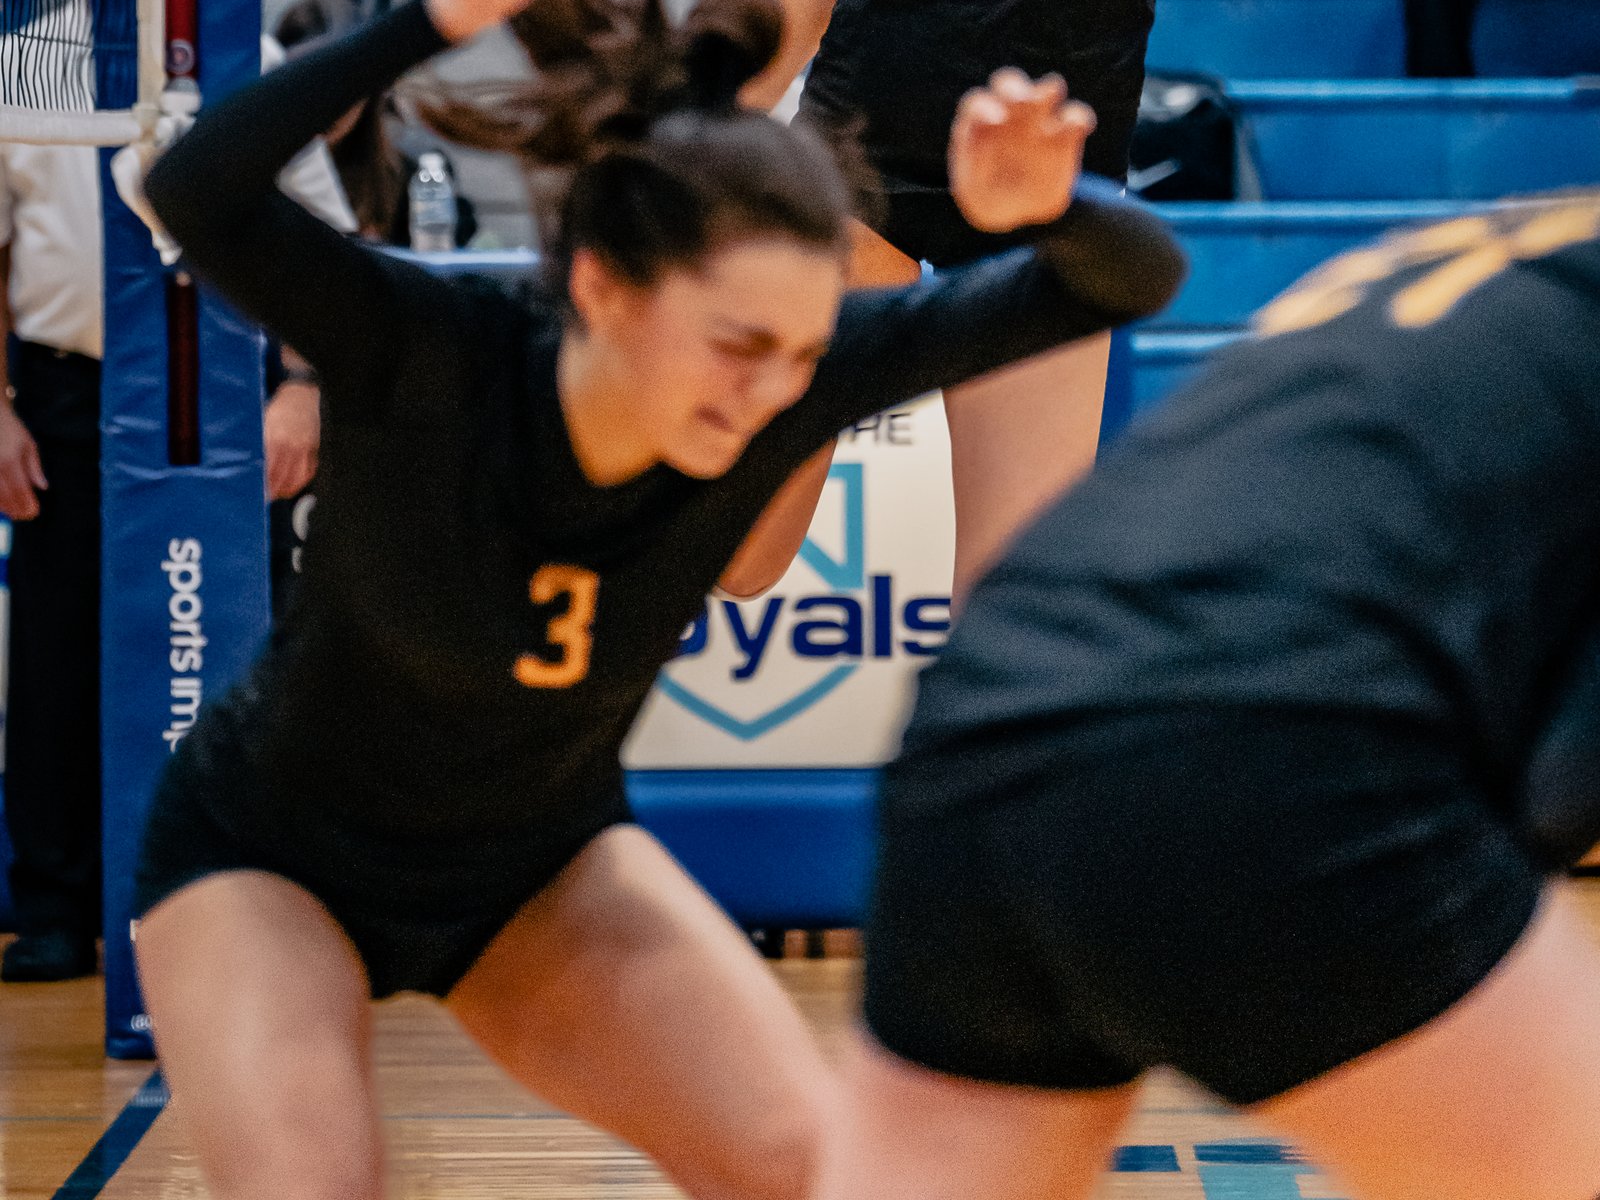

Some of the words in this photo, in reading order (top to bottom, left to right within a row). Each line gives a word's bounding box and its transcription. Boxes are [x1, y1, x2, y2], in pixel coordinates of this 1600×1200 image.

[848, 411, 913, 447] HE
[160, 537, 208, 672] sports
[513, 563, 600, 688] 3
